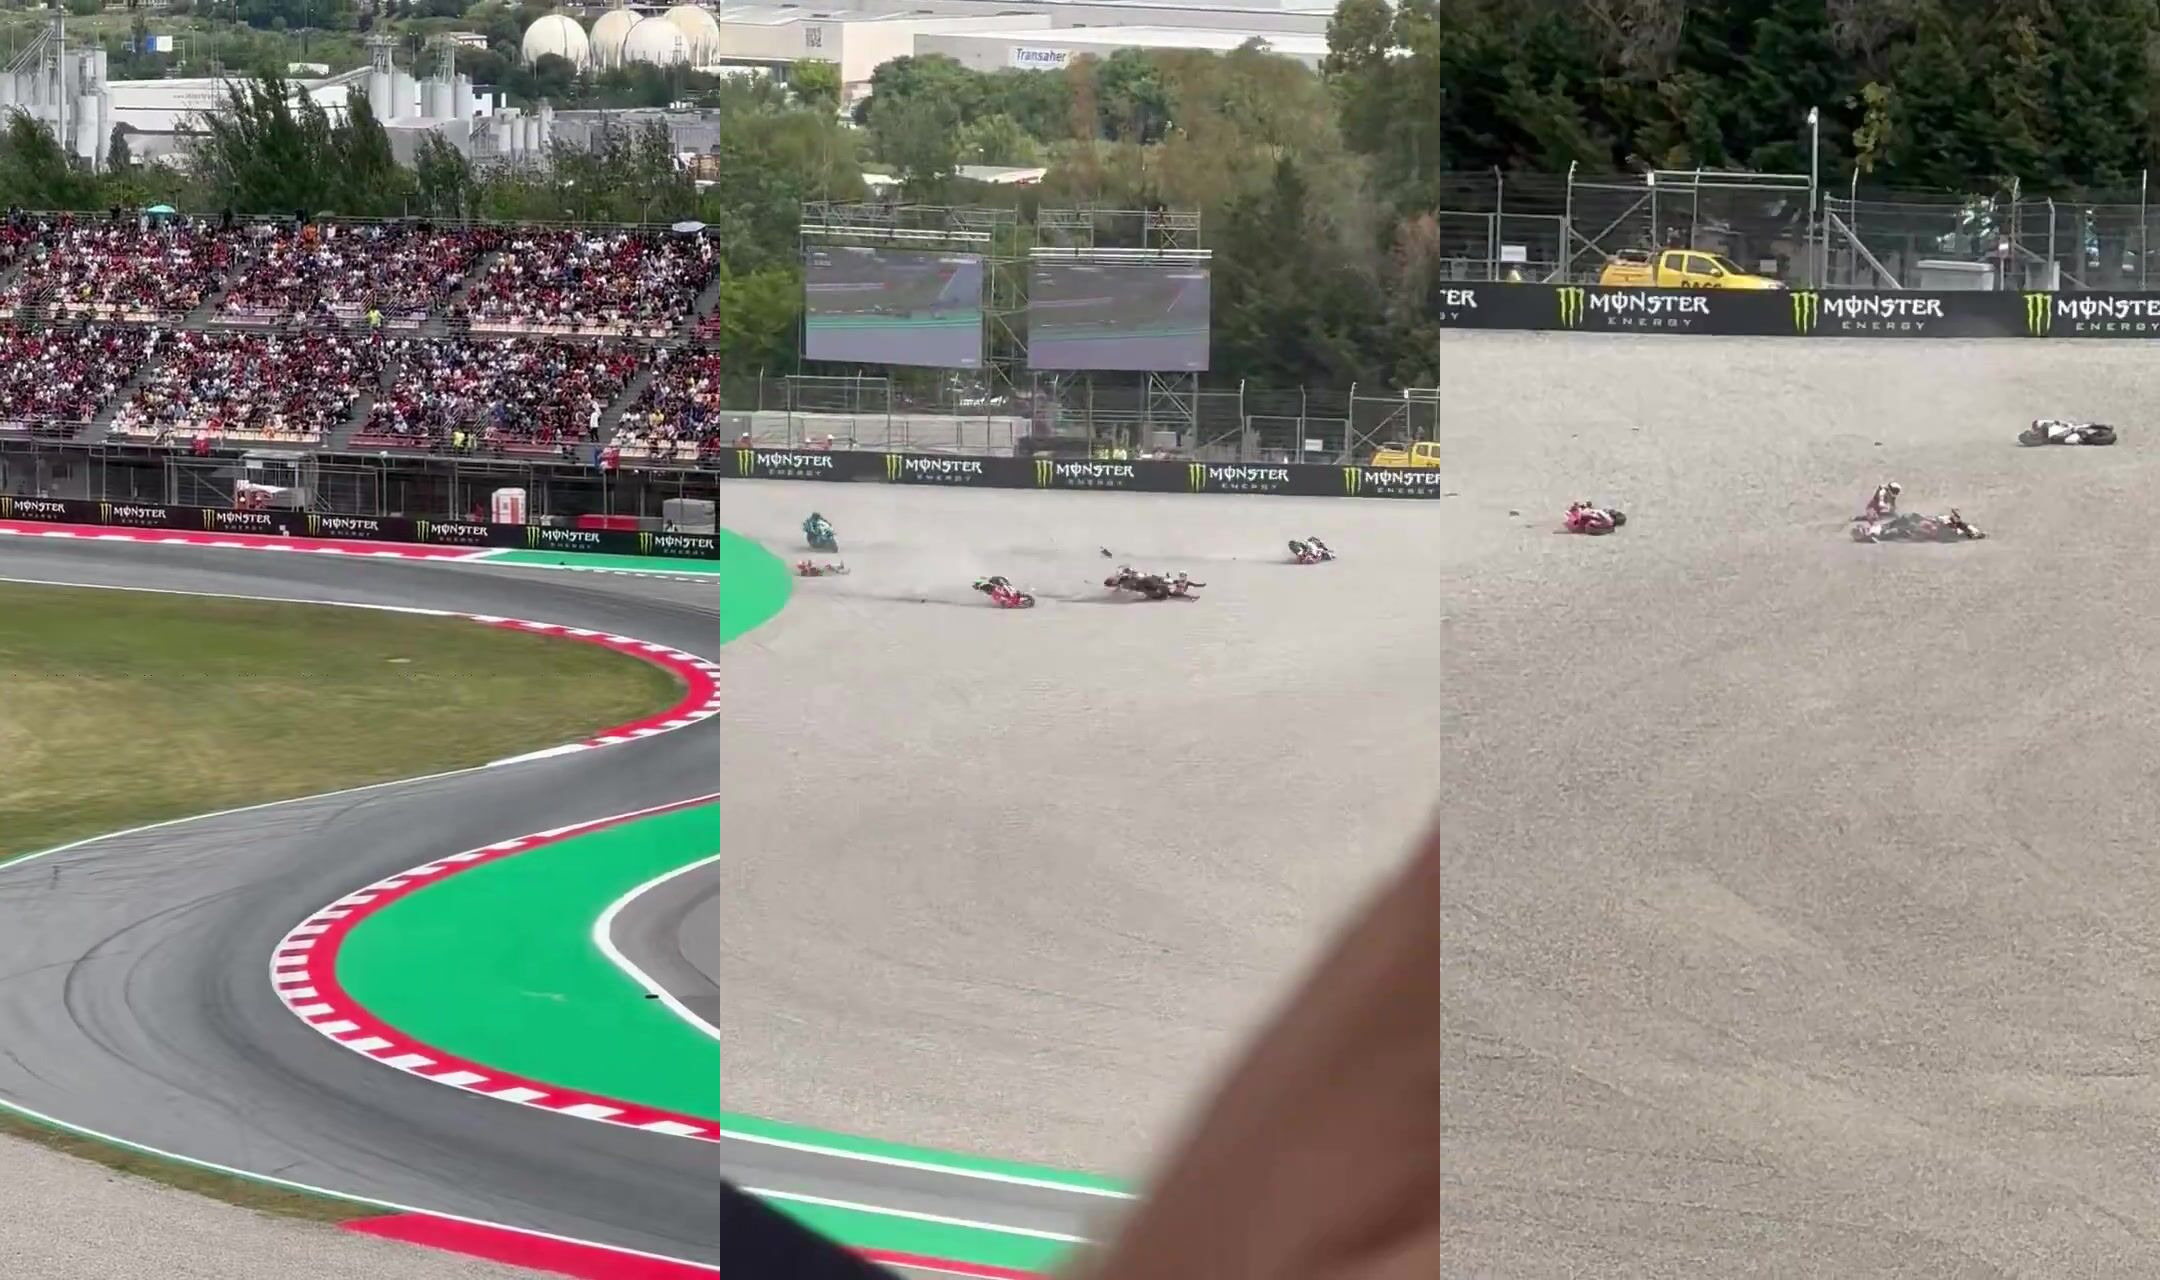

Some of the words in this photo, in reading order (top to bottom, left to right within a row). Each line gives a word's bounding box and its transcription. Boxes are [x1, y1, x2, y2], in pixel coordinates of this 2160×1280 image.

[1016, 48, 1067, 62] Transaher
[1590, 291, 1710, 314] MONSTER
[1824, 294, 1944, 319] MONSTER
[1608, 316, 1692, 327] ENERGY
[1842, 321, 1924, 331] ENERGY
[757, 453, 833, 469] MONSTER
[905, 457, 982, 474] MONSTER
[1056, 462, 1135, 478] MONSTER
[1209, 466, 1289, 482] MONSTER
[14, 500, 66, 513] MONSTER
[113, 506, 166, 519] MONSTER
[216, 511, 271, 525] MONSTER
[322, 517, 378, 531] MONSTER
[431, 522, 488, 537] MONSTER
[541, 529, 600, 543] MONSTER
[655, 536, 714, 550] MONSTER
